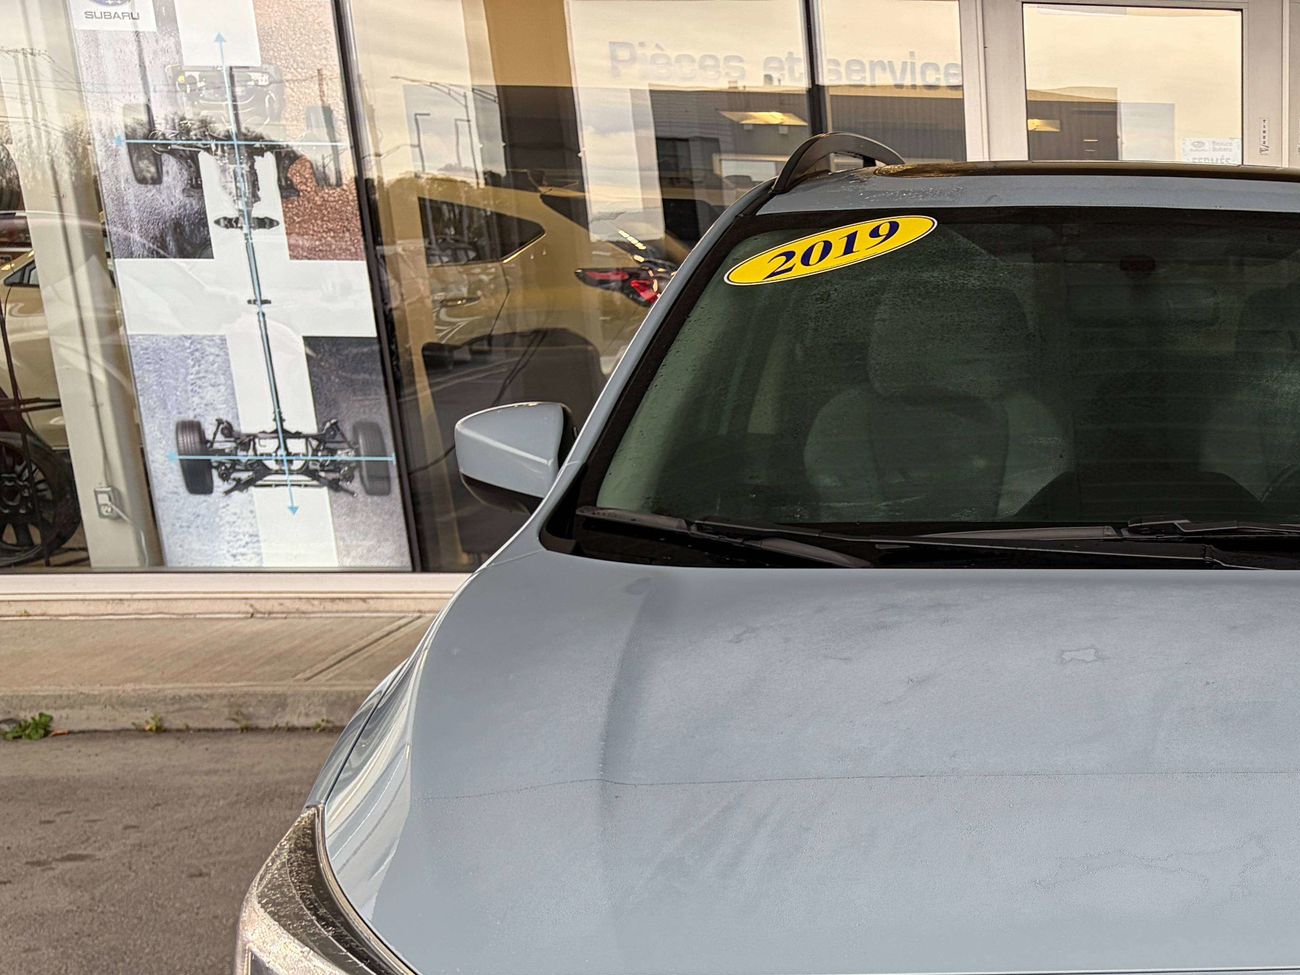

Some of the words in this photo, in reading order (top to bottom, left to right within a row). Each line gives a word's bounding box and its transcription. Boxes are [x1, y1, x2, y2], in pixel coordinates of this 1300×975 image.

[84, 11, 140, 20] SUBARU
[608, 41, 746, 82] Pièces
[763, 51, 803, 82] et
[826, 50, 962, 90] service
[763, 220, 900, 280] 2019
